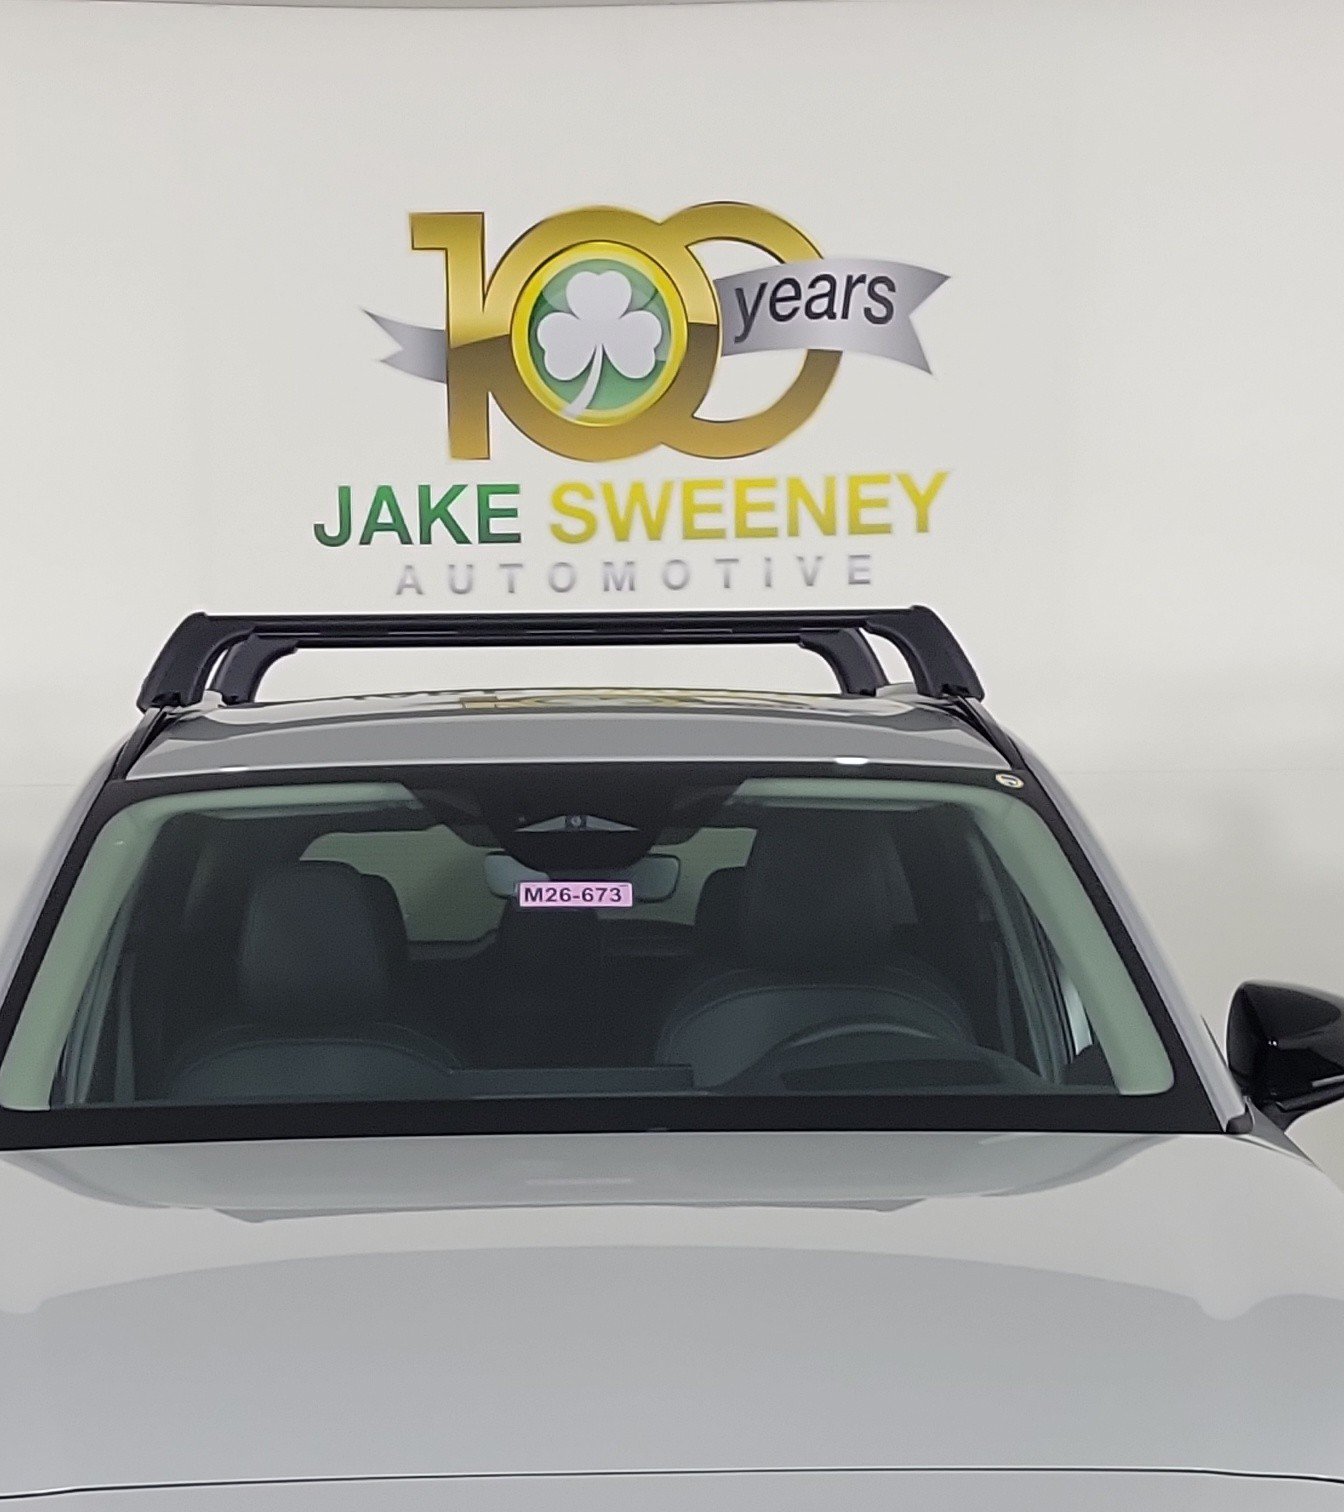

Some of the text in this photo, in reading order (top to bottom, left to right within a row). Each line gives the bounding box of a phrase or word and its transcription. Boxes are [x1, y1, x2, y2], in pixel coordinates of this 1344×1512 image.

[410, 201, 897, 461] 100 years
[313, 471, 951, 547] JAKE SWEENEY
[395, 554, 873, 595] AUTOMOTIVE
[524, 887, 623, 902] M26-673
